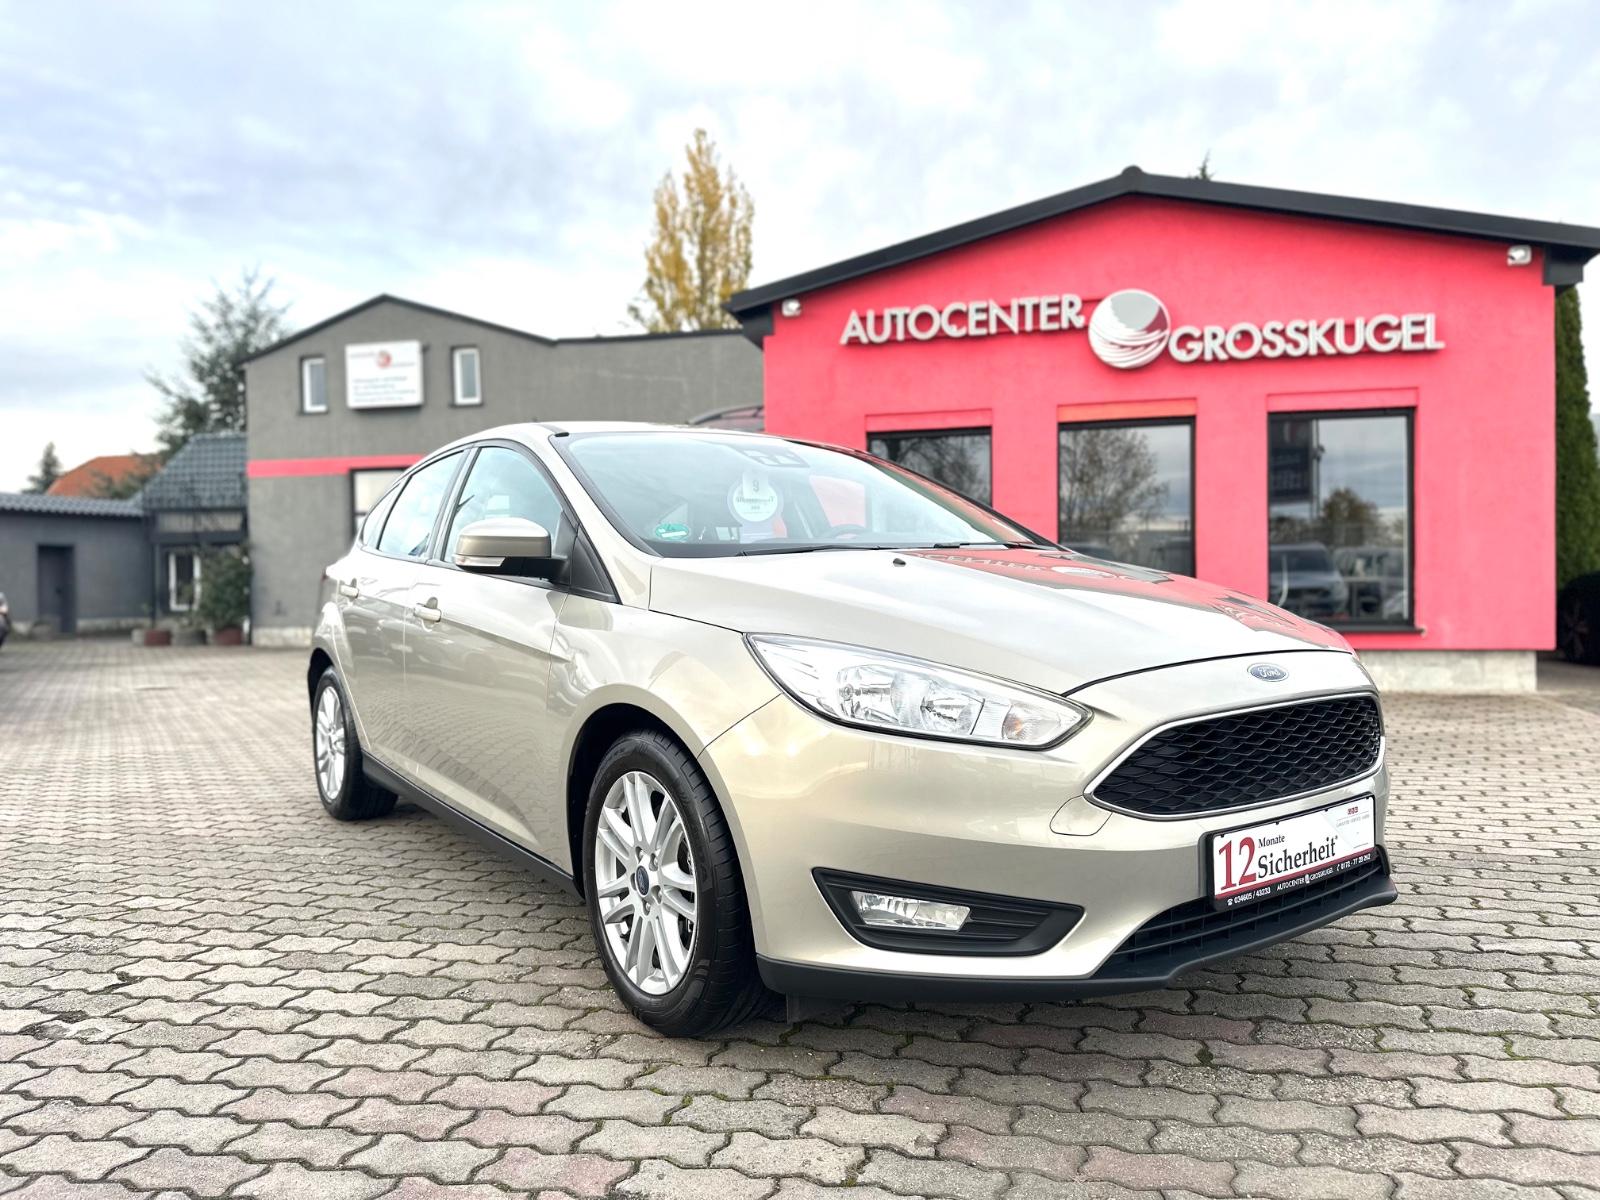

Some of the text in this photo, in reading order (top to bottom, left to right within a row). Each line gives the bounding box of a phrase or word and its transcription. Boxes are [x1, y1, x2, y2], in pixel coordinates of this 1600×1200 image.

[840, 294, 1085, 346] AUTOCENTER
[1168, 313, 1445, 363] GROSSKUGEL
[1218, 837, 1257, 890] 12
[1258, 835, 1285, 849] Monate
[1277, 878, 1304, 891] AUTOCENTER
